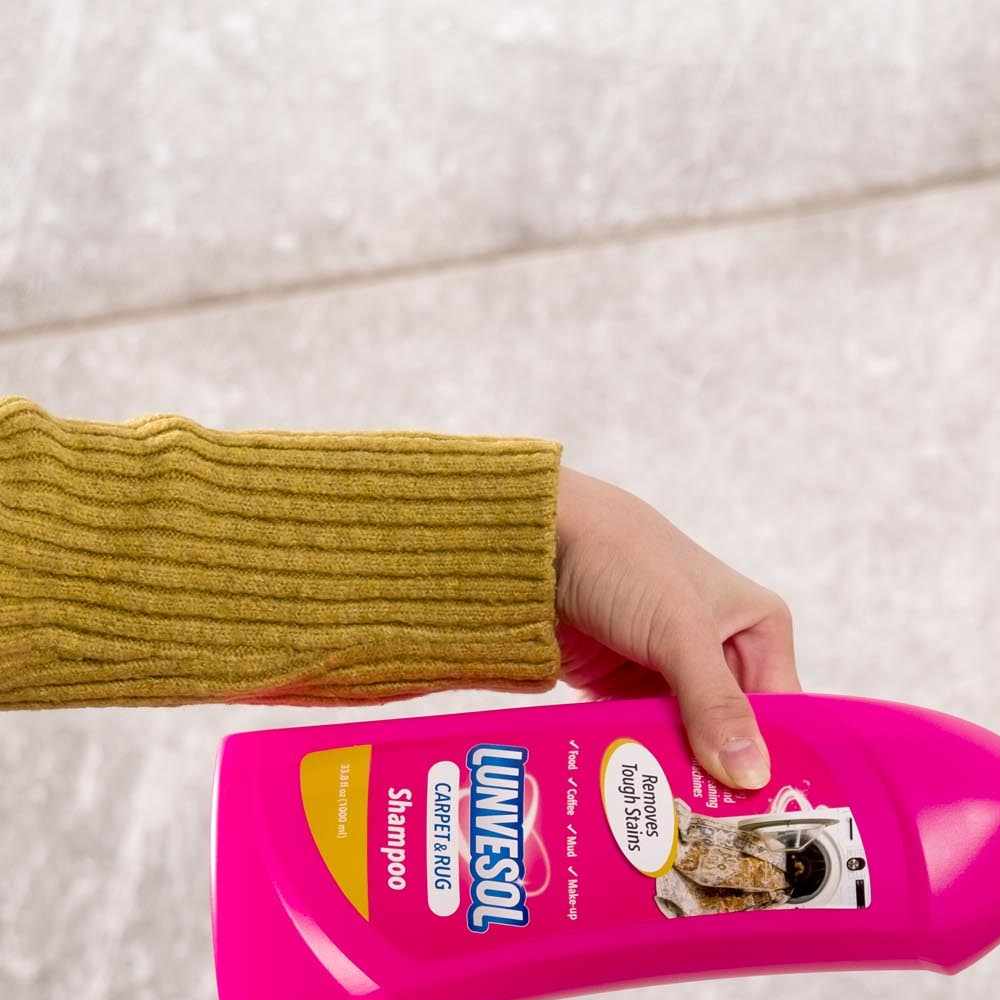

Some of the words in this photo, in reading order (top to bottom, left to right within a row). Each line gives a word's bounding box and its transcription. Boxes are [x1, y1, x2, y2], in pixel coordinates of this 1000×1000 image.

[567, 749, 580, 771] Food
[566, 788, 579, 816] Coffee
[618, 763, 641, 804] Tough
[434, 782, 452, 841] CARPET
[641, 774, 659, 838] Removes
[380, 787, 413, 891] Shampoo
[433, 842, 448, 852] &
[471, 747, 525, 928] LUNVESOL
[566, 835, 578, 858] Mud
[624, 808, 644, 852] Stains
[434, 854, 452, 891] RUG
[567, 878, 579, 921] Make-up
